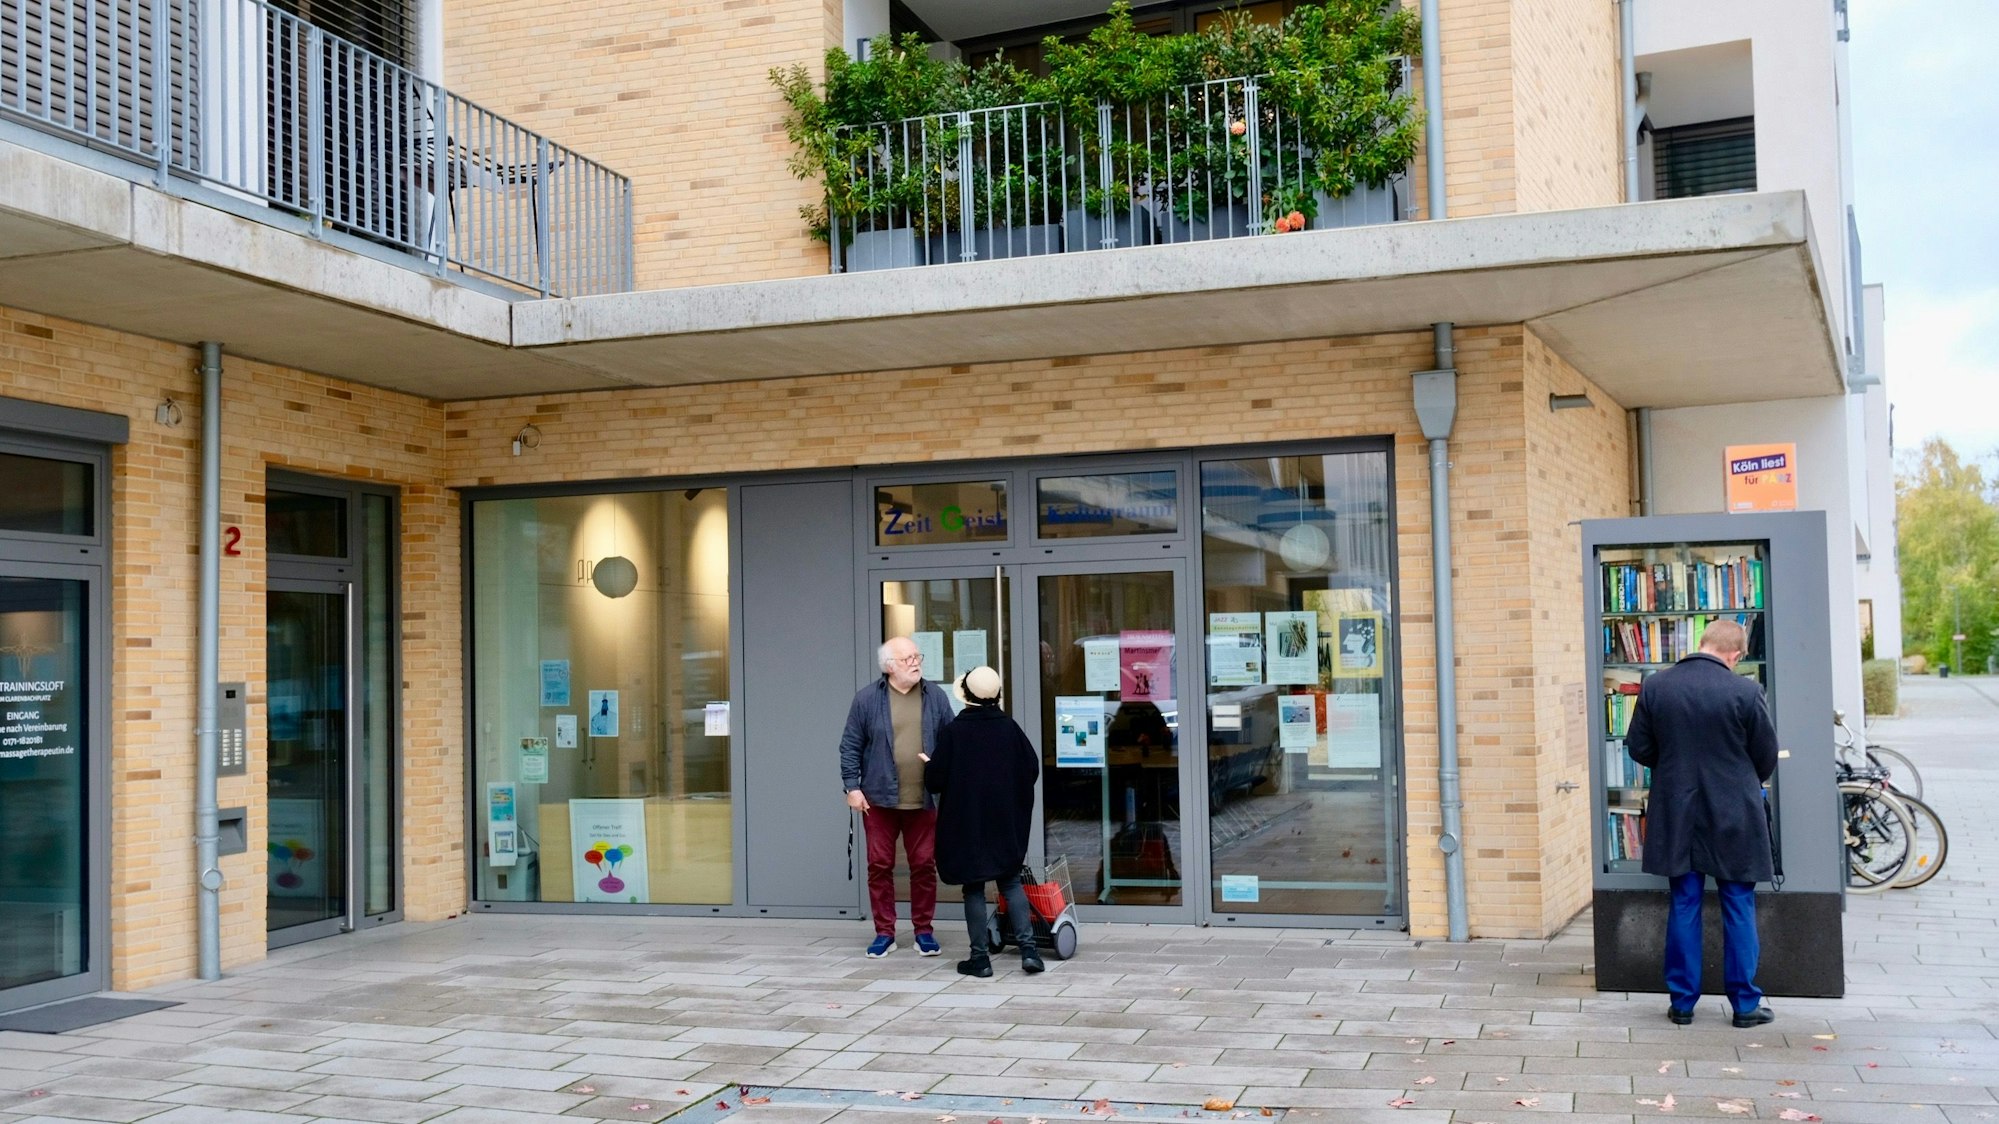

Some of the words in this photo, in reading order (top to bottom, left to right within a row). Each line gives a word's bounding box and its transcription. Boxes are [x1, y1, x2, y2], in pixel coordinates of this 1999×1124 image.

[1733, 461, 1759, 473] Köln
[1761, 456, 1785, 468] liest
[1745, 475, 1758, 485] für
[884, 508, 932, 534] Zeit
[941, 505, 1004, 532] Geist
[225, 526, 241, 556] 2
[0, 681, 64, 692] TRAININGSLOFT
[7, 711, 40, 720] EINGANG
[6, 724, 23, 733] nach
[23, 722, 67, 732] Vereinbarung
